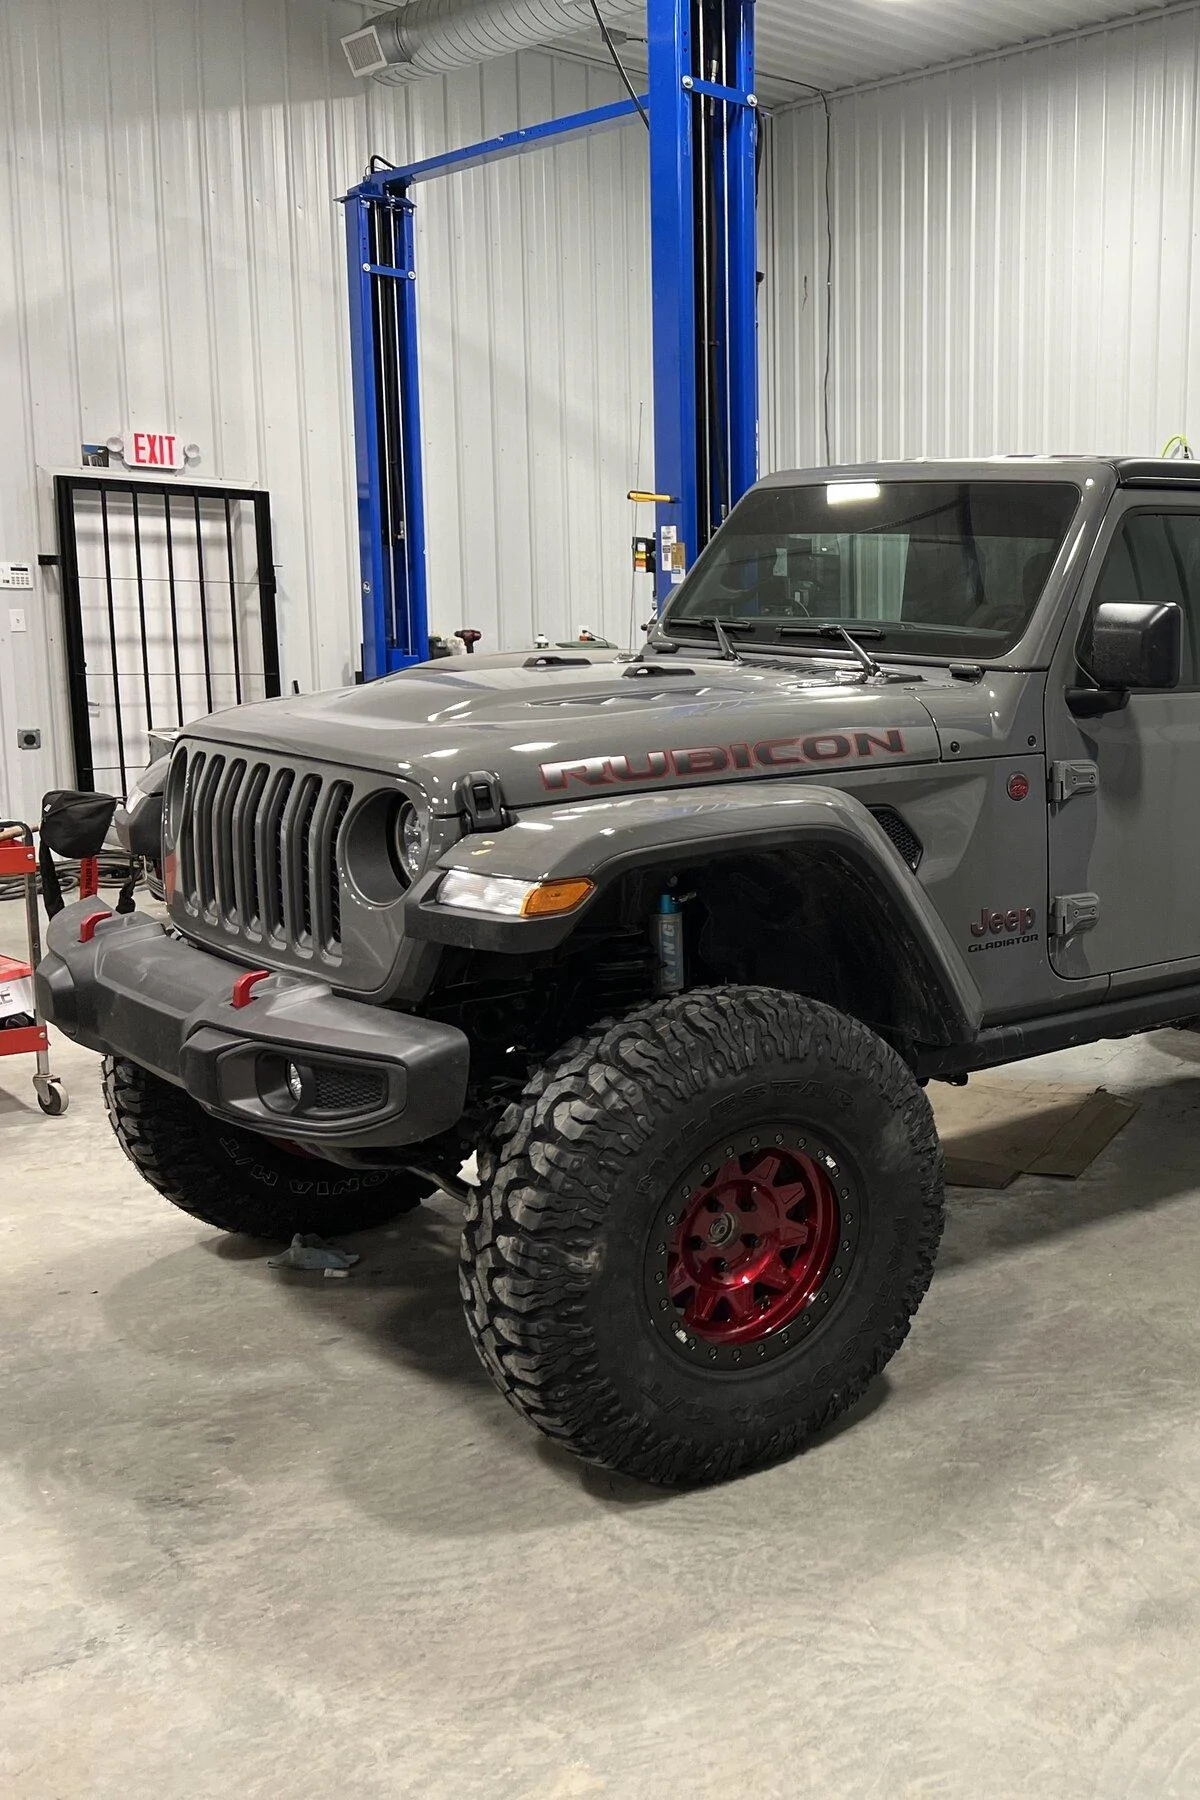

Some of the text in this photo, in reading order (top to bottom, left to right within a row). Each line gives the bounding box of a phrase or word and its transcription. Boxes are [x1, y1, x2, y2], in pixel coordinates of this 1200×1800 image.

[133, 433, 176, 466] EXIT
[540, 729, 905, 790] RUBICON
[970, 907, 1037, 938] Jeep
[662, 922, 677, 983] KING
[967, 933, 1039, 953] GLADIATOR
